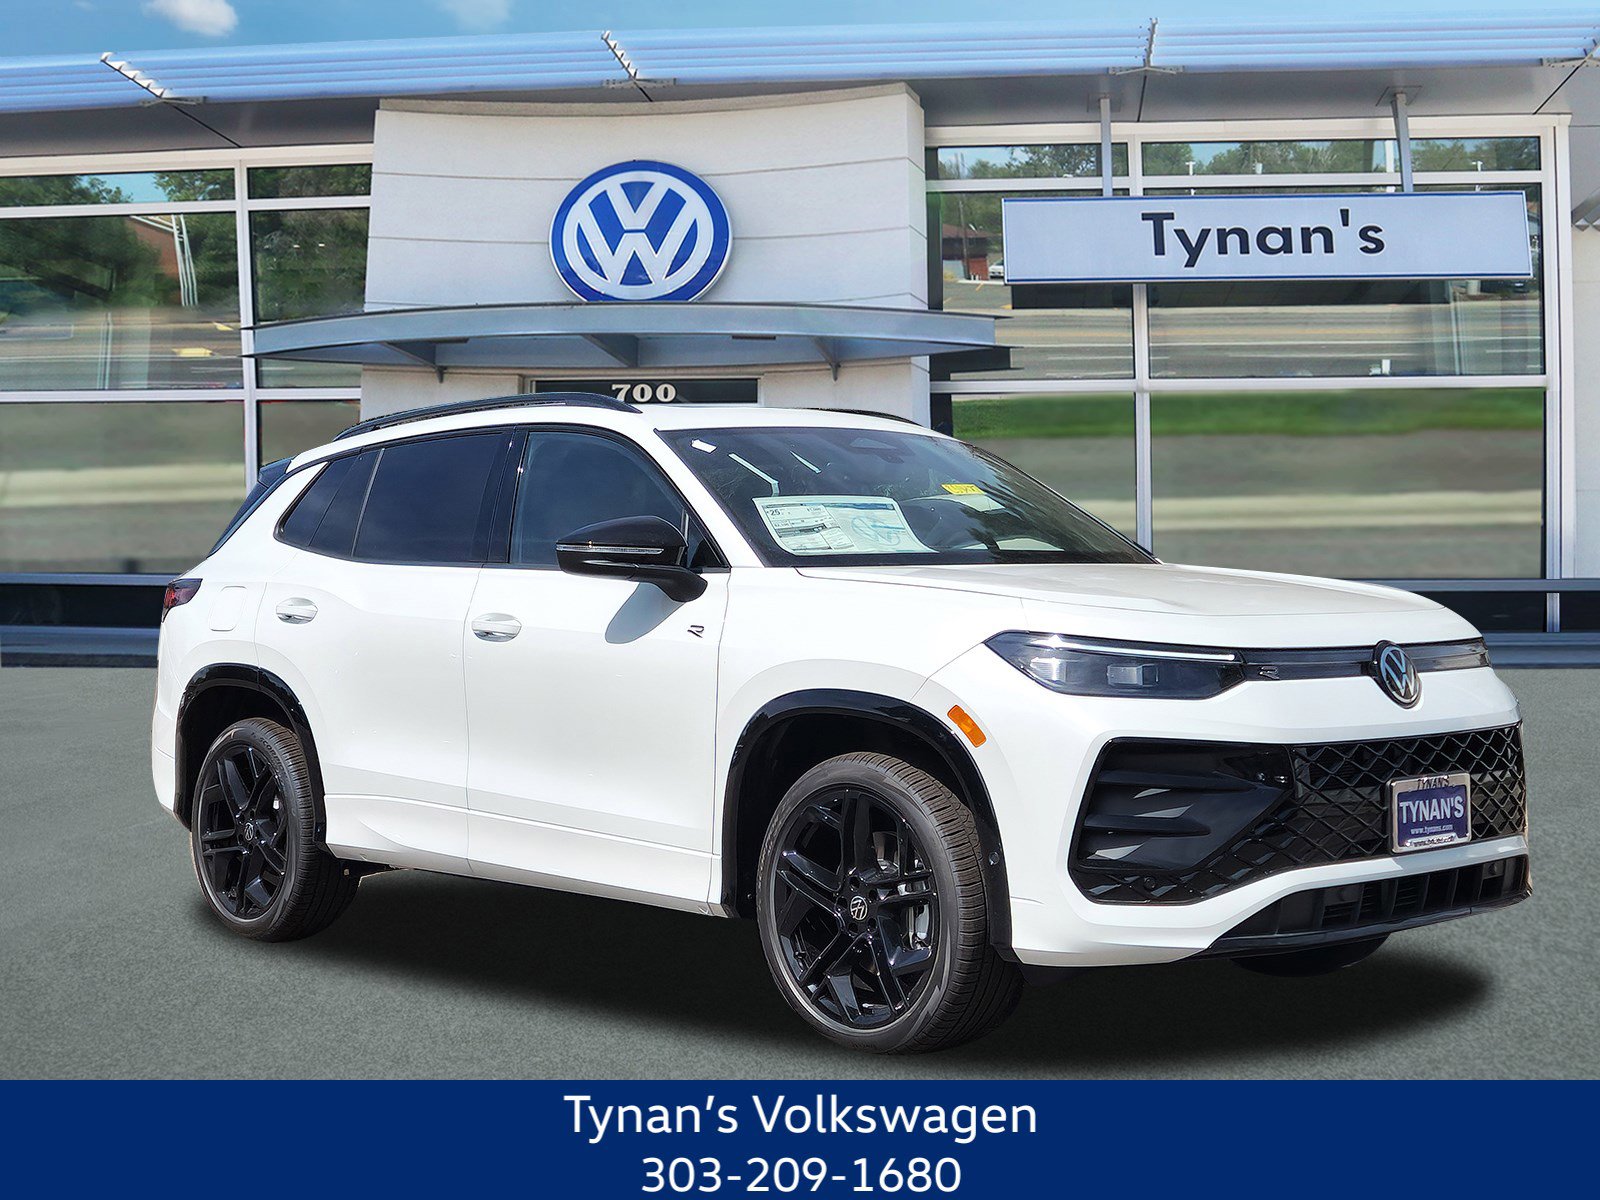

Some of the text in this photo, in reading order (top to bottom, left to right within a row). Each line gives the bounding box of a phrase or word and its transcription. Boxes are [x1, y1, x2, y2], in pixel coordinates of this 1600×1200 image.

[1141, 208, 1385, 268] Tynan's
[611, 383, 677, 403] 700
[1399, 795, 1464, 823] TYNAN'S
